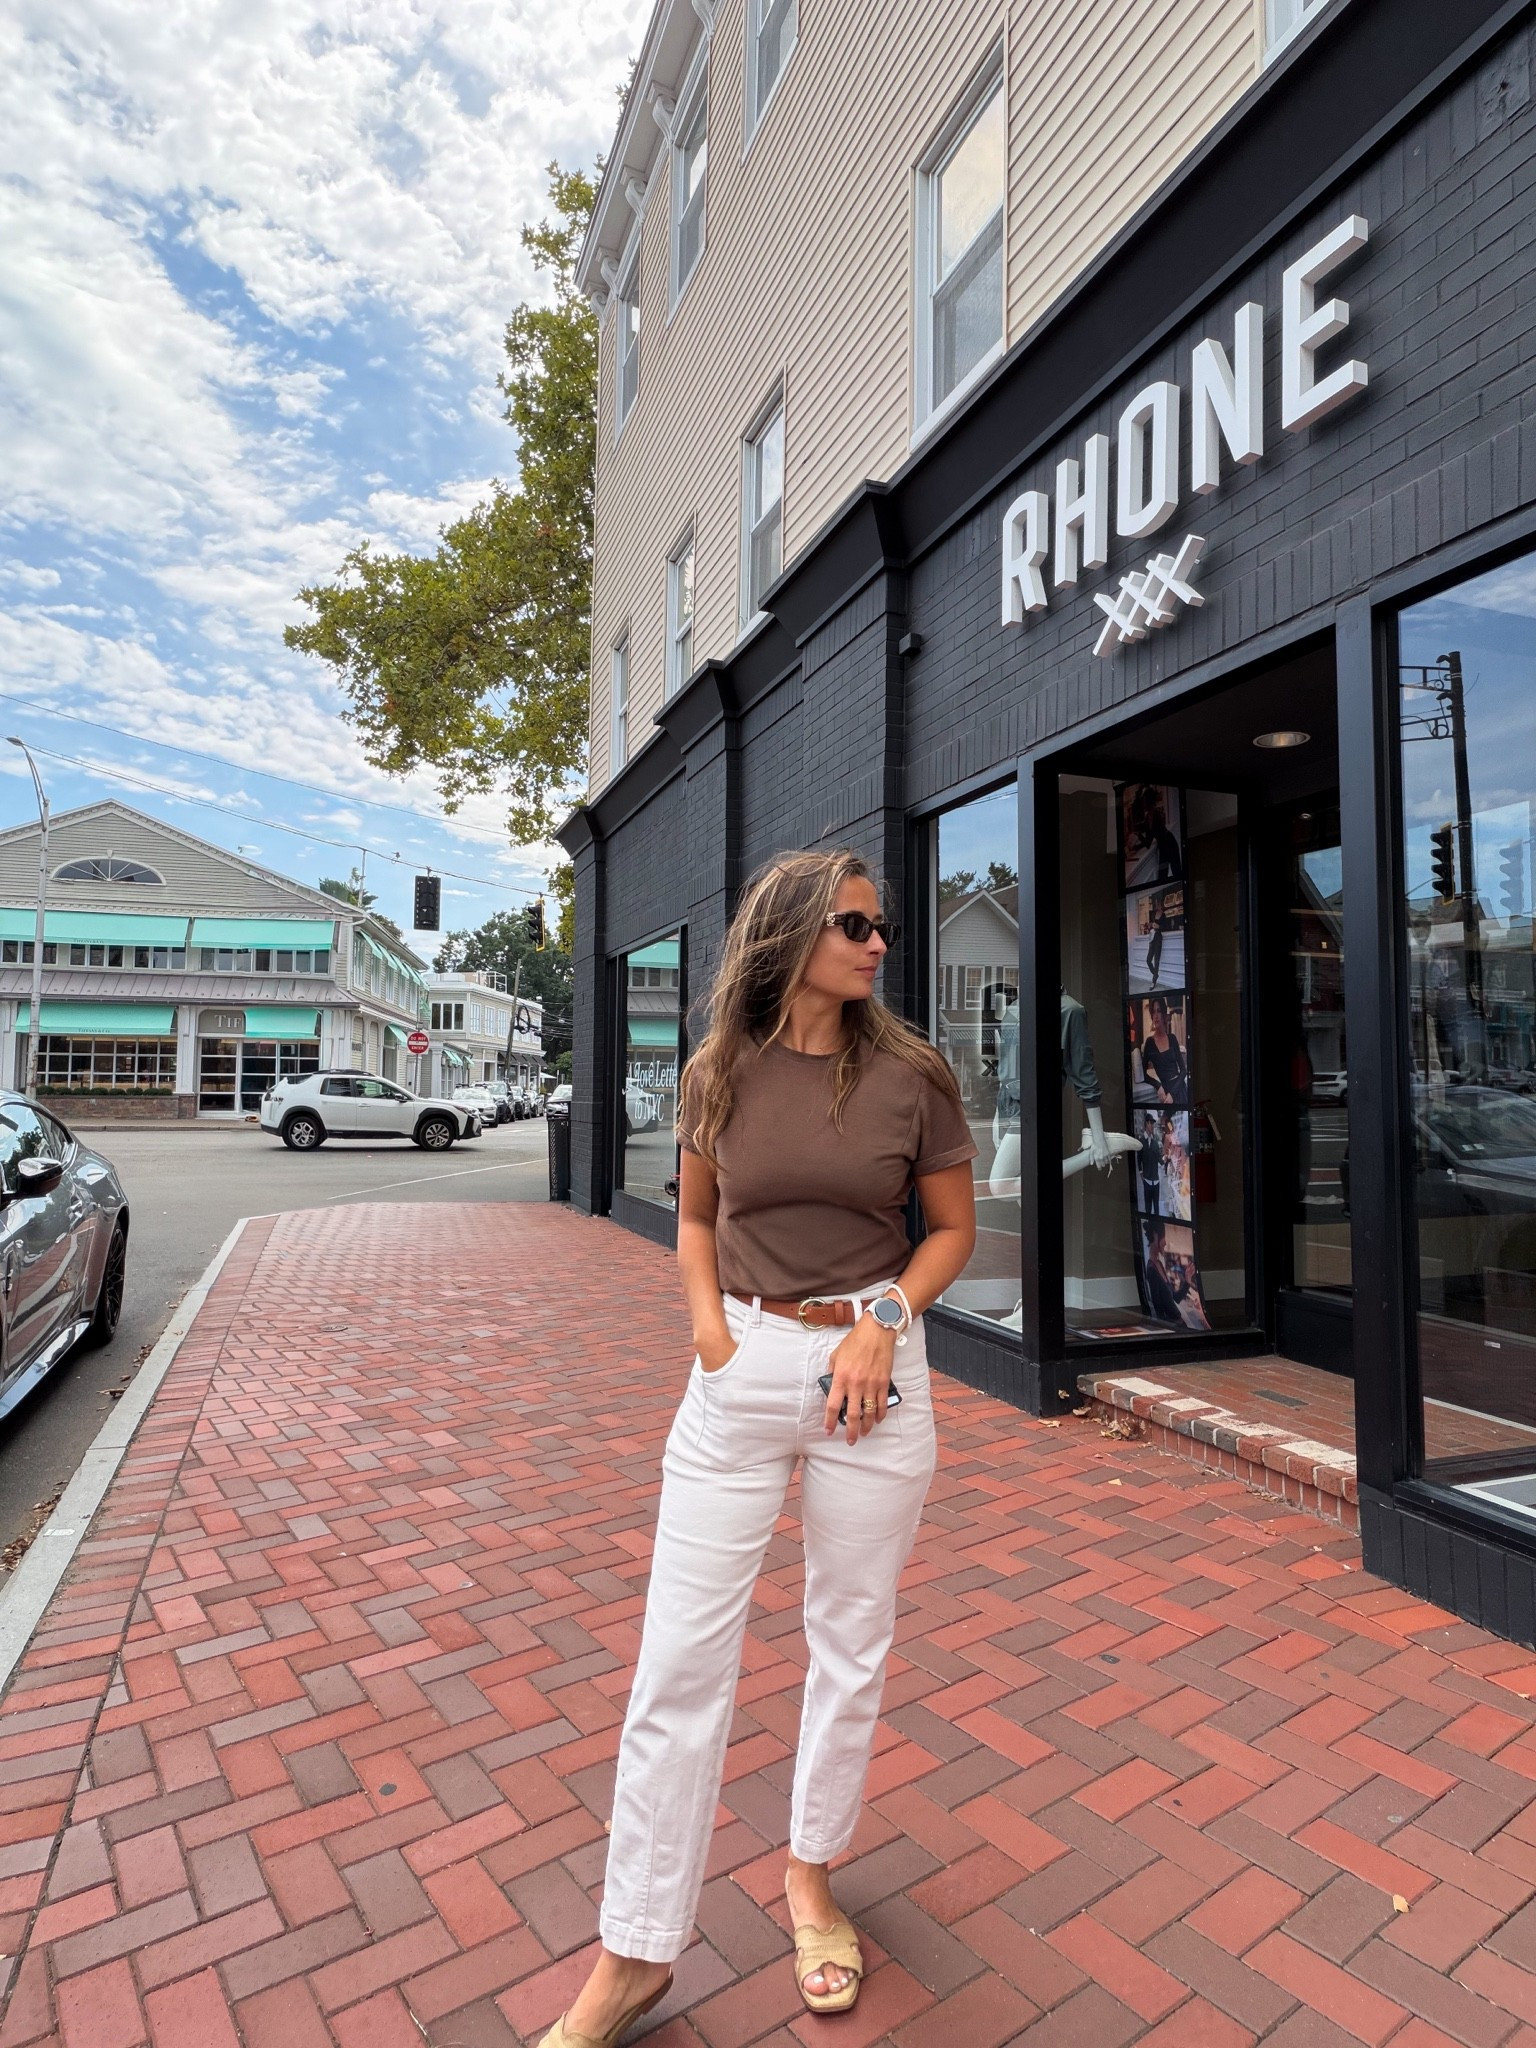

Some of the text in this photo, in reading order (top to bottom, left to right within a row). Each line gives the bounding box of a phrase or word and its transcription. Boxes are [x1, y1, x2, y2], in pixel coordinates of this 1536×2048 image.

[1002, 214, 1368, 628] RHONE
[654, 1060, 678, 1088] Lette
[643, 1093, 665, 1122] NYC
